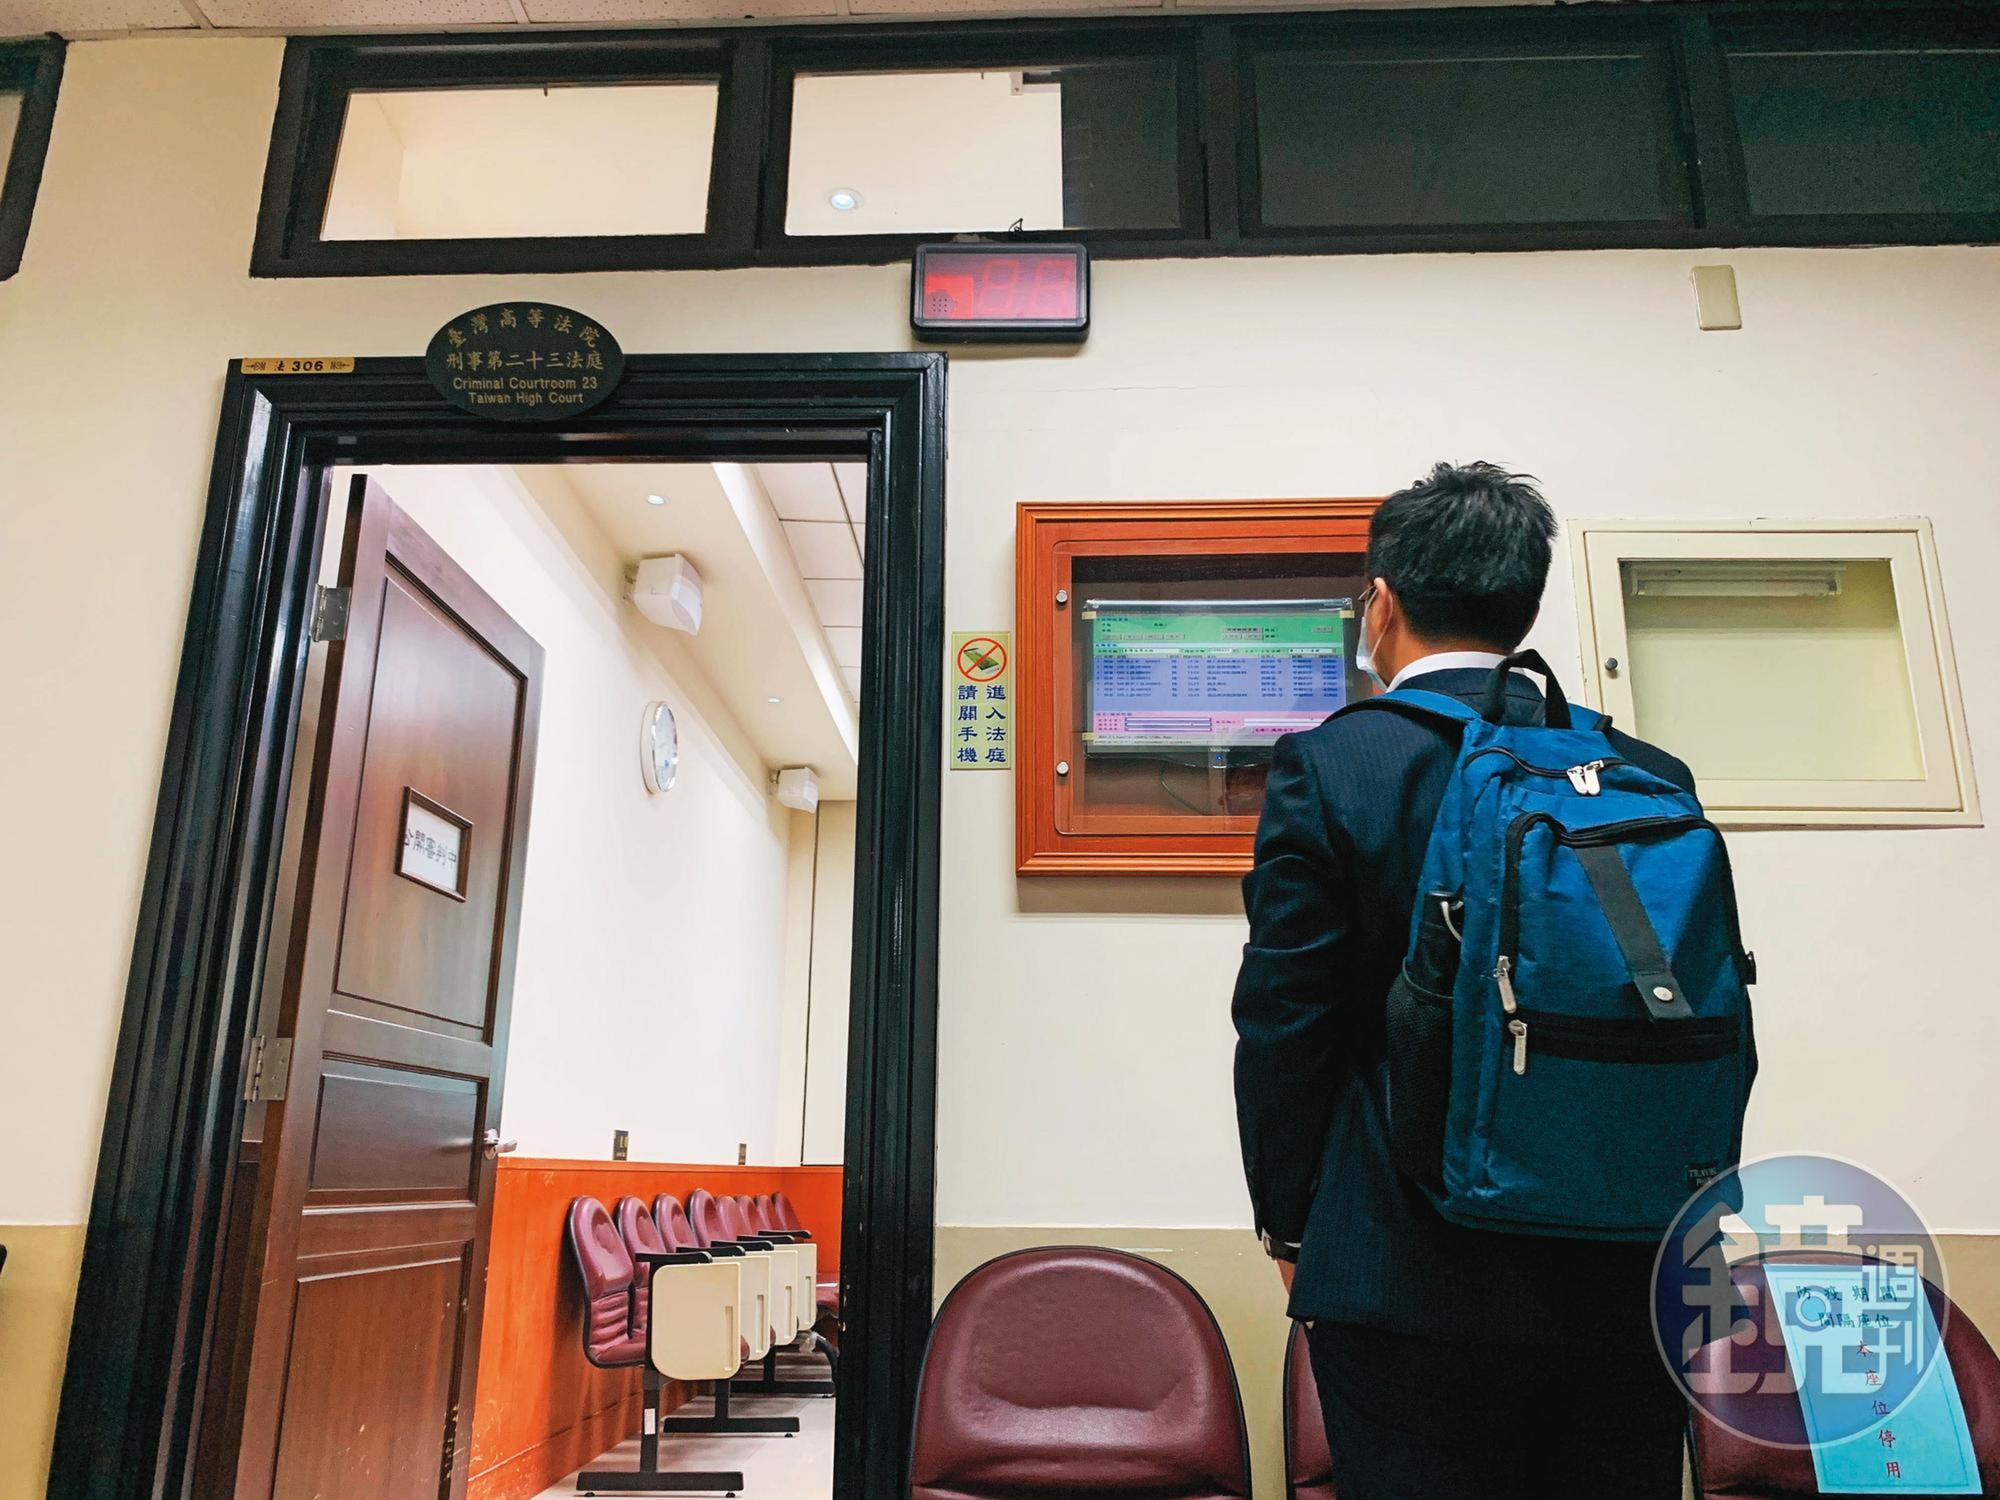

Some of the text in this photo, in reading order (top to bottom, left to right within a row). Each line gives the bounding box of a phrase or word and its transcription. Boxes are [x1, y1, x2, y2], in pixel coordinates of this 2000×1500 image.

[447, 308, 600, 348] 臺灣高等法院
[291, 360, 325, 372] 306
[446, 350, 604, 371] 刑事第二十三法庭
[452, 376, 599, 390] Criminal Courtroom 23
[468, 391, 584, 407] Taiwan High Court
[957, 684, 979, 763] 請關手機
[985, 684, 1007, 763] 進入法庭
